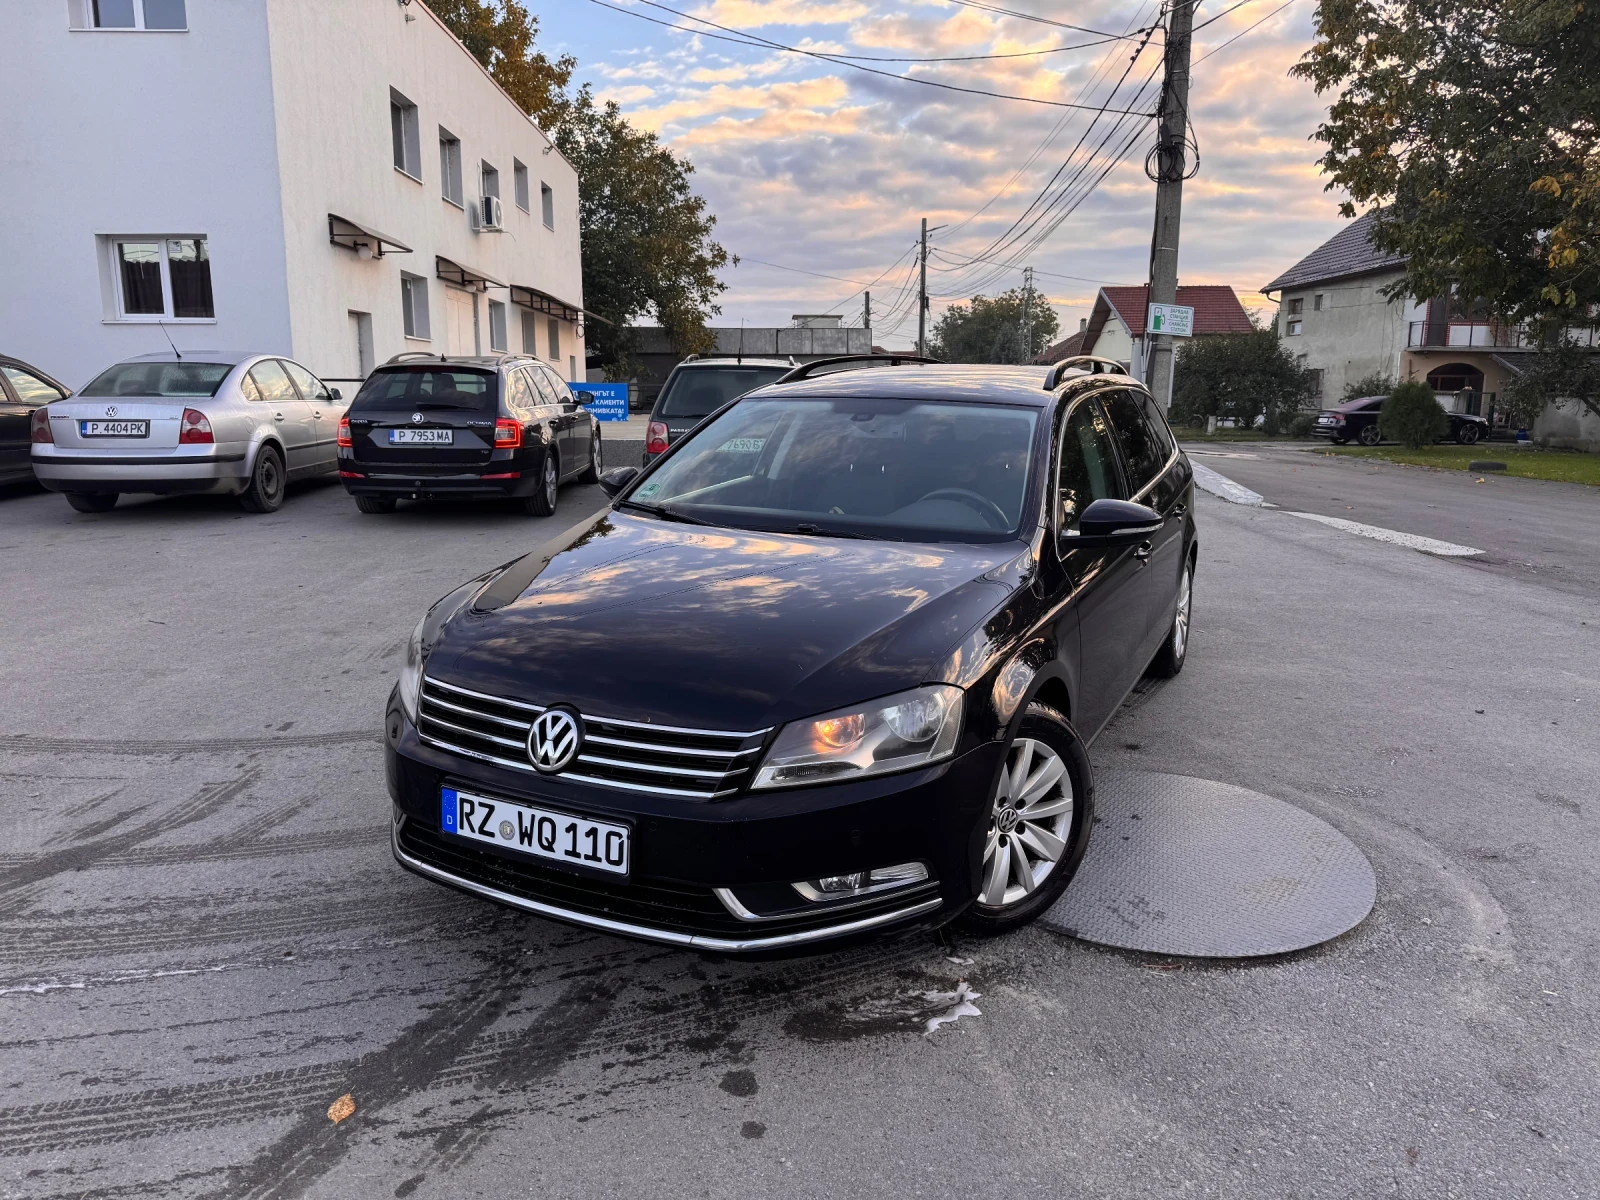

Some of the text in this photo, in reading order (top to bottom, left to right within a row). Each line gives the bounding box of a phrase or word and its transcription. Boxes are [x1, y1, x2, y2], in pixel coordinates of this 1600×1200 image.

[91, 423, 144, 434] P 4404 PK
[398, 430, 451, 442] P 7953 MA
[446, 814, 453, 825] D
[459, 797, 496, 838] RZ
[517, 810, 557, 853] WQ
[564, 822, 625, 867] 110
